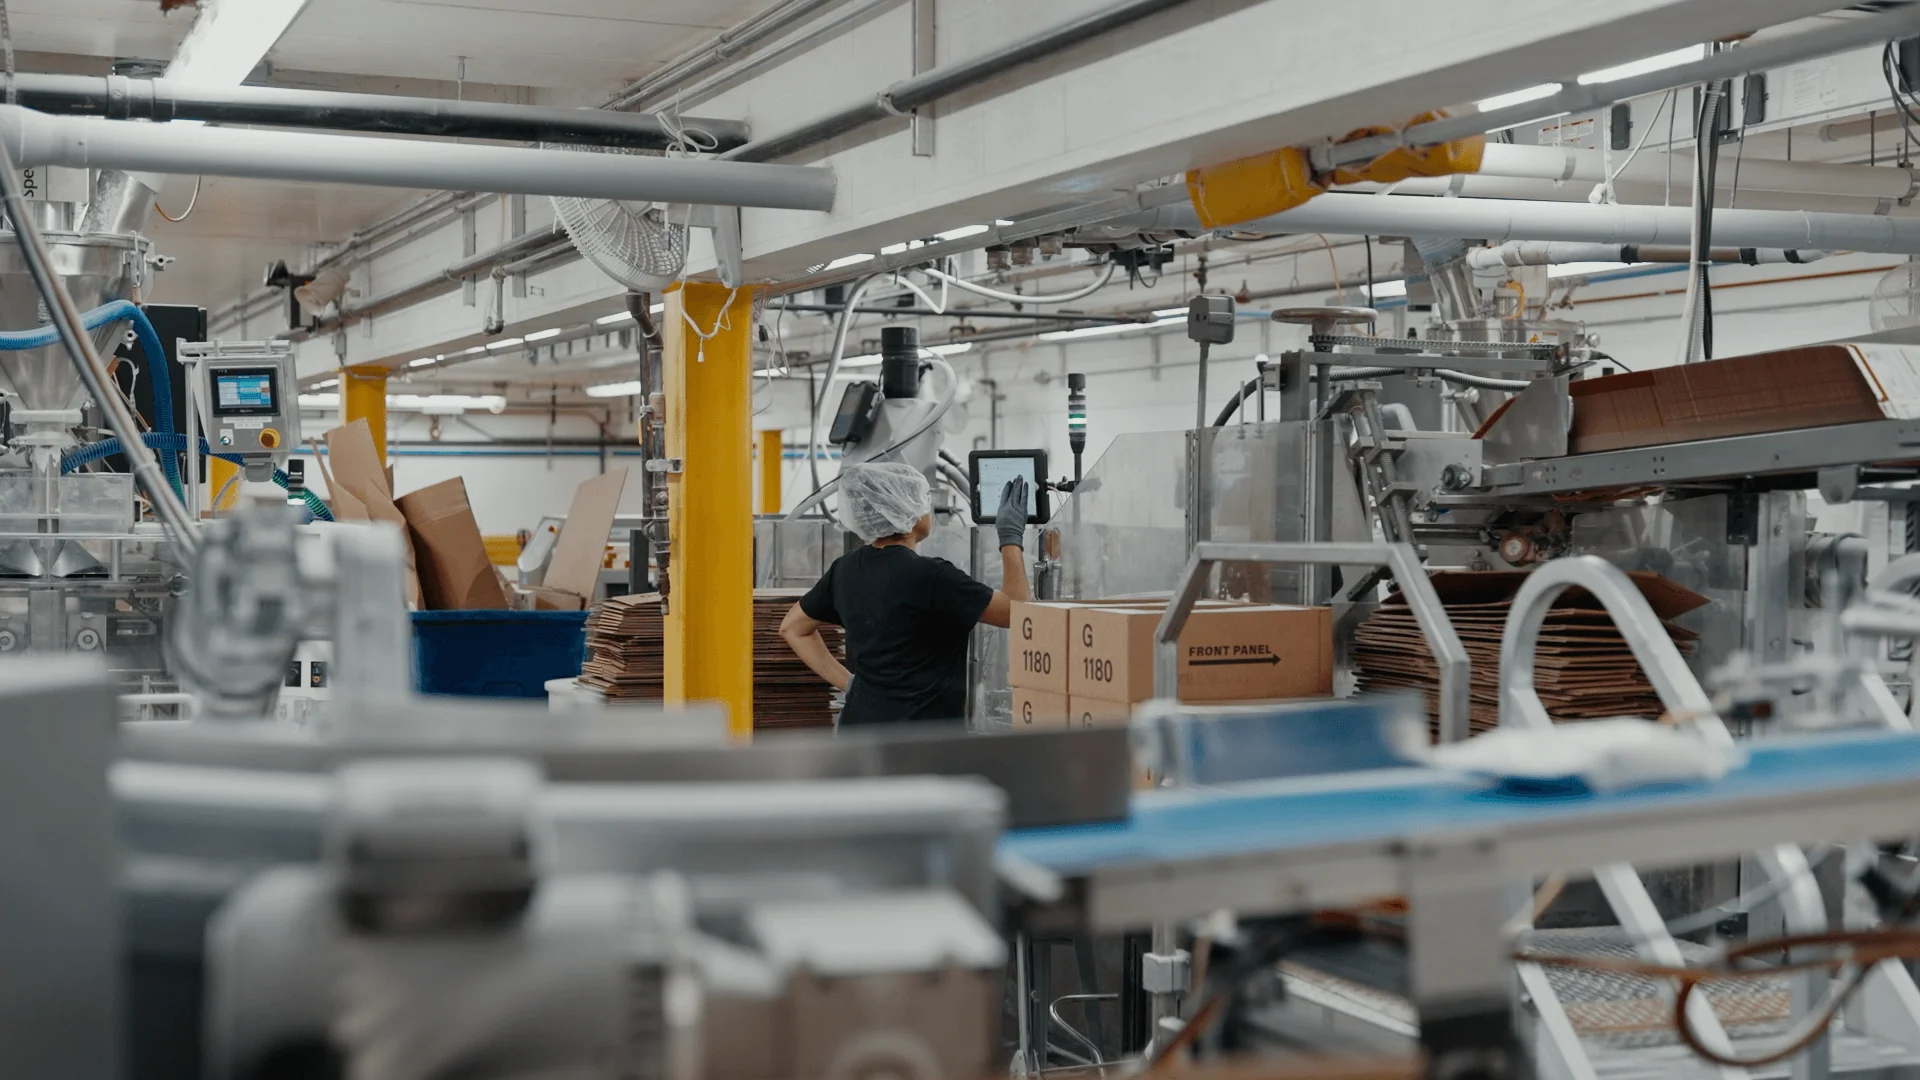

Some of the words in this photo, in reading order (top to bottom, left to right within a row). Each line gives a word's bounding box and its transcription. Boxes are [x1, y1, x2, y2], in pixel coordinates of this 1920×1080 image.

[1022, 617, 1033, 640] G
[1082, 623, 1093, 648] G
[1023, 649, 1052, 675] 1180
[1188, 645, 1231, 657] FRONT
[1233, 644, 1272, 656] PANEL
[1083, 657, 1113, 683] 1180
[1022, 701, 1033, 725] G
